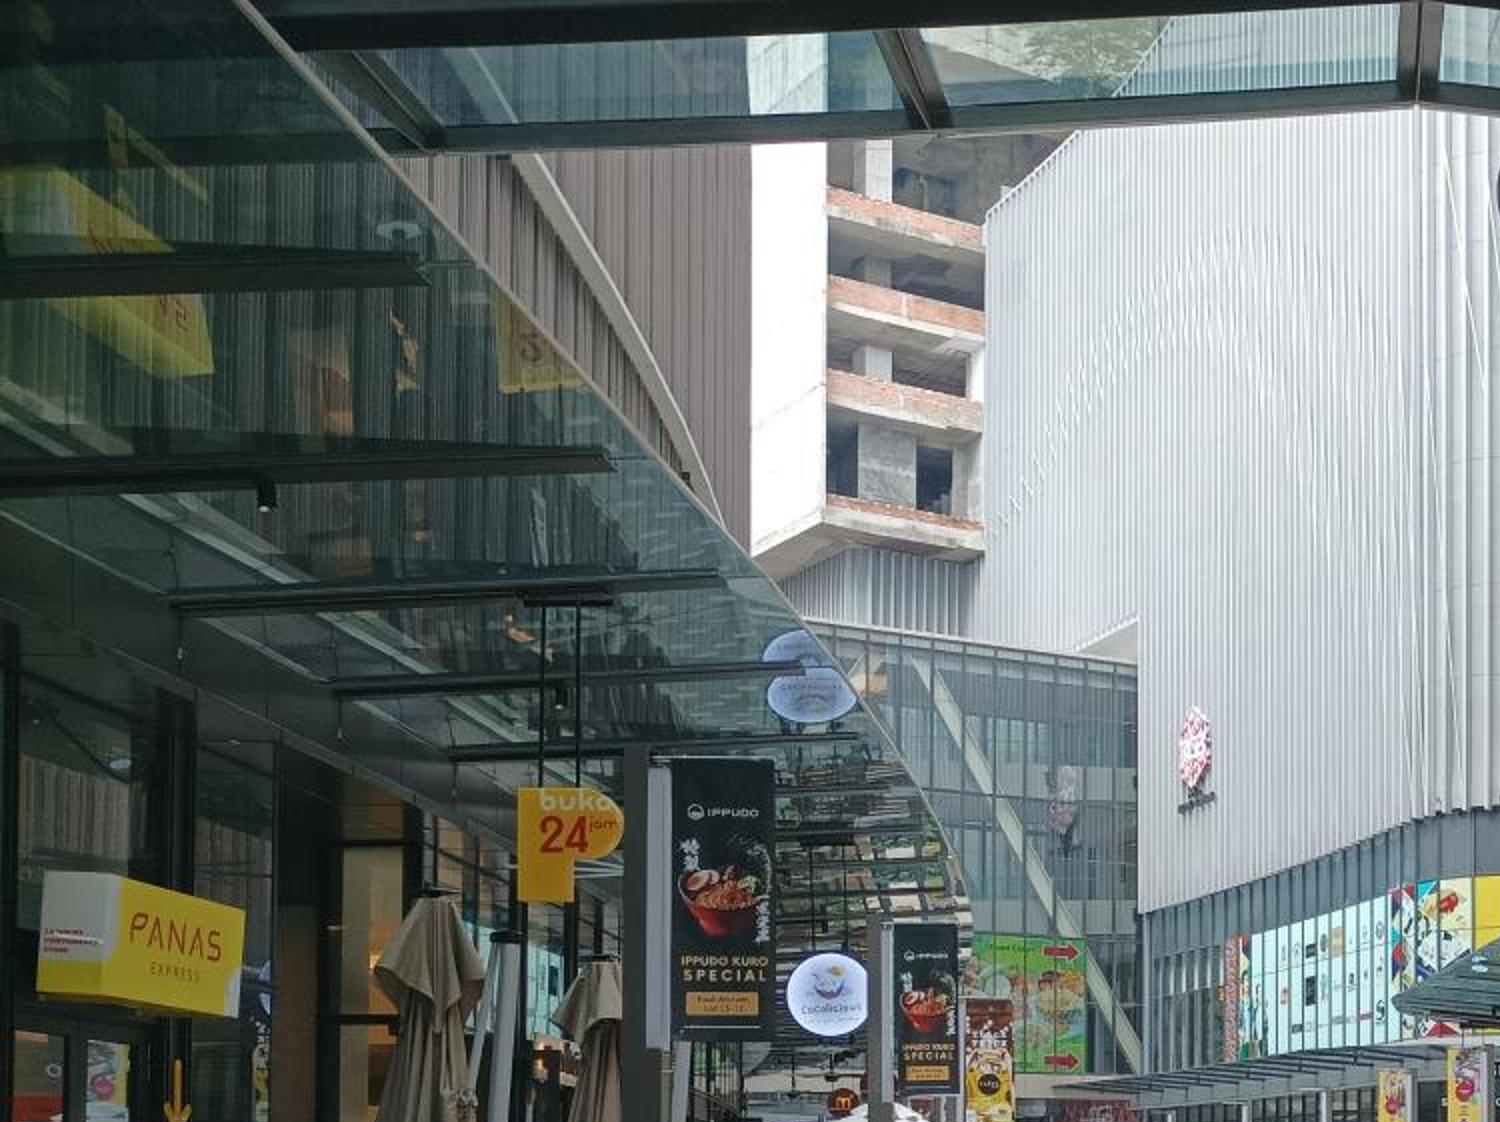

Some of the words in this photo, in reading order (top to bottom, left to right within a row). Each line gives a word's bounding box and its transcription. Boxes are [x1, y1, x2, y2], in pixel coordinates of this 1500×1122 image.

[707, 808, 760, 817] IPPUDO
[540, 815, 589, 853] 24
[130, 911, 222, 962] PANAS
[682, 955, 729, 967] IPPUDO
[732, 955, 769, 967] KURO
[151, 961, 201, 983] EXPRESS
[683, 969, 767, 982] SPECIAL
